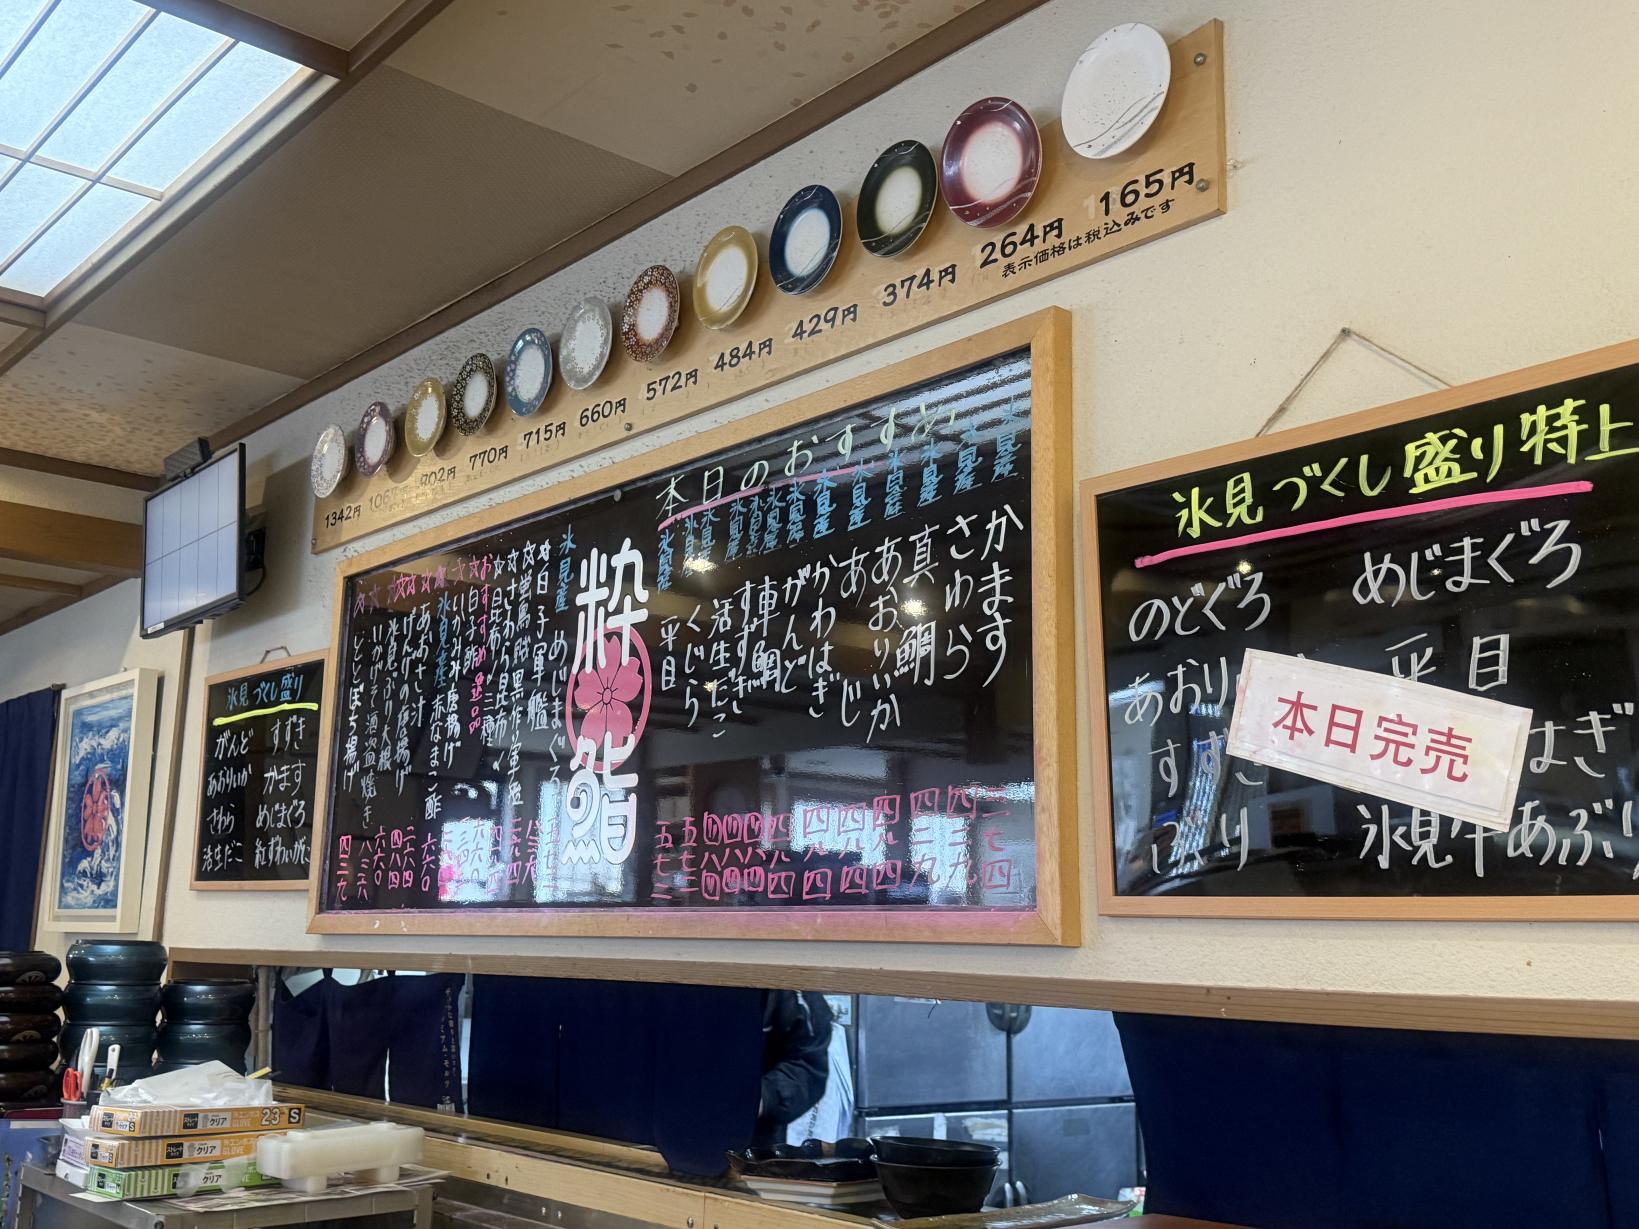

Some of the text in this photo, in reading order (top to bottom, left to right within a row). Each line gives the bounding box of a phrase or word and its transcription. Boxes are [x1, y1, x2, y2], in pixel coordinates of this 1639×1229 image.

[1100, 162, 1196, 216] 165円
[979, 217, 1064, 269] 264円
[1002, 198, 1176, 279] 表示価格は税込みです
[882, 263, 957, 307] 374円
[791, 303, 858, 341] 429円
[713, 338, 773, 372] 484円
[645, 368, 699, 401] 572円
[523, 421, 566, 450] 715円
[579, 397, 627, 427] 660円
[469, 445, 509, 471] 770円
[1171, 398, 1639, 539] 氷見づくし盛り特上
[325, 504, 361, 528] 1342円
[555, 523, 577, 613] 氷見産
[1352, 518, 1581, 607] めじまぐろ
[893, 523, 940, 688] 真鯛
[943, 514, 979, 681] さわら
[977, 503, 1024, 688] かます
[1129, 571, 1271, 641] のどぐろ
[433, 591, 452, 689] 氷見産
[733, 580, 762, 714] すずき
[752, 575, 781, 693] 車鯛
[781, 562, 811, 694] がんど
[808, 554, 842, 718] かわはぎ
[839, 547, 869, 727] あじ
[866, 536, 903, 744] あおりいか
[660, 616, 681, 692] 平目
[684, 604, 705, 728] くじら
[227, 673, 304, 712] 氷見づくし盛り
[214, 728, 254, 760] がんど
[271, 715, 306, 756] すずき
[1271, 690, 1473, 783] 本日完売
[207, 763, 252, 799] あおりいか
[263, 760, 306, 797] かます
[206, 803, 236, 835] さわら
[256, 800, 306, 832] めじまぐろ
[209, 1117, 227, 1127] クリア
[261, 1107, 281, 1126] 23
[290, 1109, 300, 1123] S
[196, 1145, 217, 1156] クリア
[202, 1173, 223, 1185] クリア
